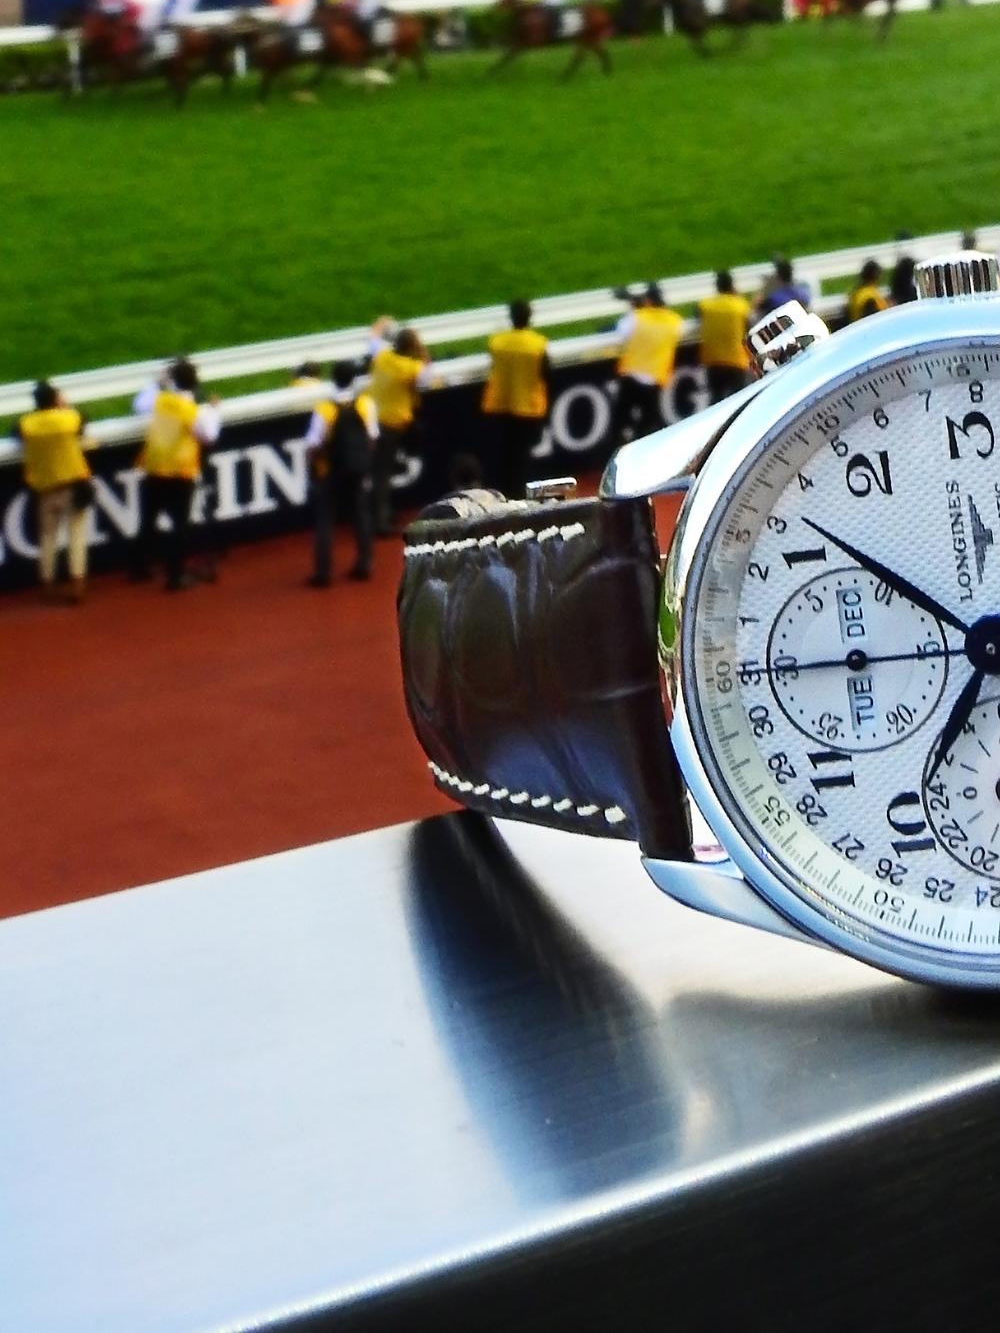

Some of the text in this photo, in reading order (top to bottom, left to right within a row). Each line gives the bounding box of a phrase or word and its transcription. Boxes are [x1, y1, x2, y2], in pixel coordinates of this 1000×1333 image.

[918, 389, 932, 412] 7
[969, 380, 984, 403] 8
[873, 408, 889, 430] 6
[830, 435, 848, 457] 5
[945, 411, 995, 460] 3
[797, 472, 814, 492] 4
[846, 450, 893, 498] 2
[767, 516, 788, 534] 3
[945, 479, 973, 602] LONGINES
[748, 562, 769, 582] 2
[781, 545, 827, 570] 1
[803, 588, 824, 613] 5
[843, 588, 866, 639] DEC
[739, 616, 760, 627] 1
[716, 660, 733, 693] 60
[853, 676, 875, 727] TUE
[749, 706, 773, 738] 30
[816, 712, 843, 741] 25
[886, 703, 913, 734] 20
[768, 752, 797, 785] 29
[807, 750, 856, 795] 11
[928, 782, 949, 812] 24
[962, 786, 977, 800] 0
[763, 795, 790, 826] 55
[796, 794, 828, 826] 28
[886, 791, 937, 858] 10
[832, 832, 865, 861] 27
[940, 819, 968, 849] 22
[875, 858, 909, 886] 26
[970, 846, 1000, 872] 20
[874, 889, 905, 913] 50
[923, 877, 955, 903] 25
